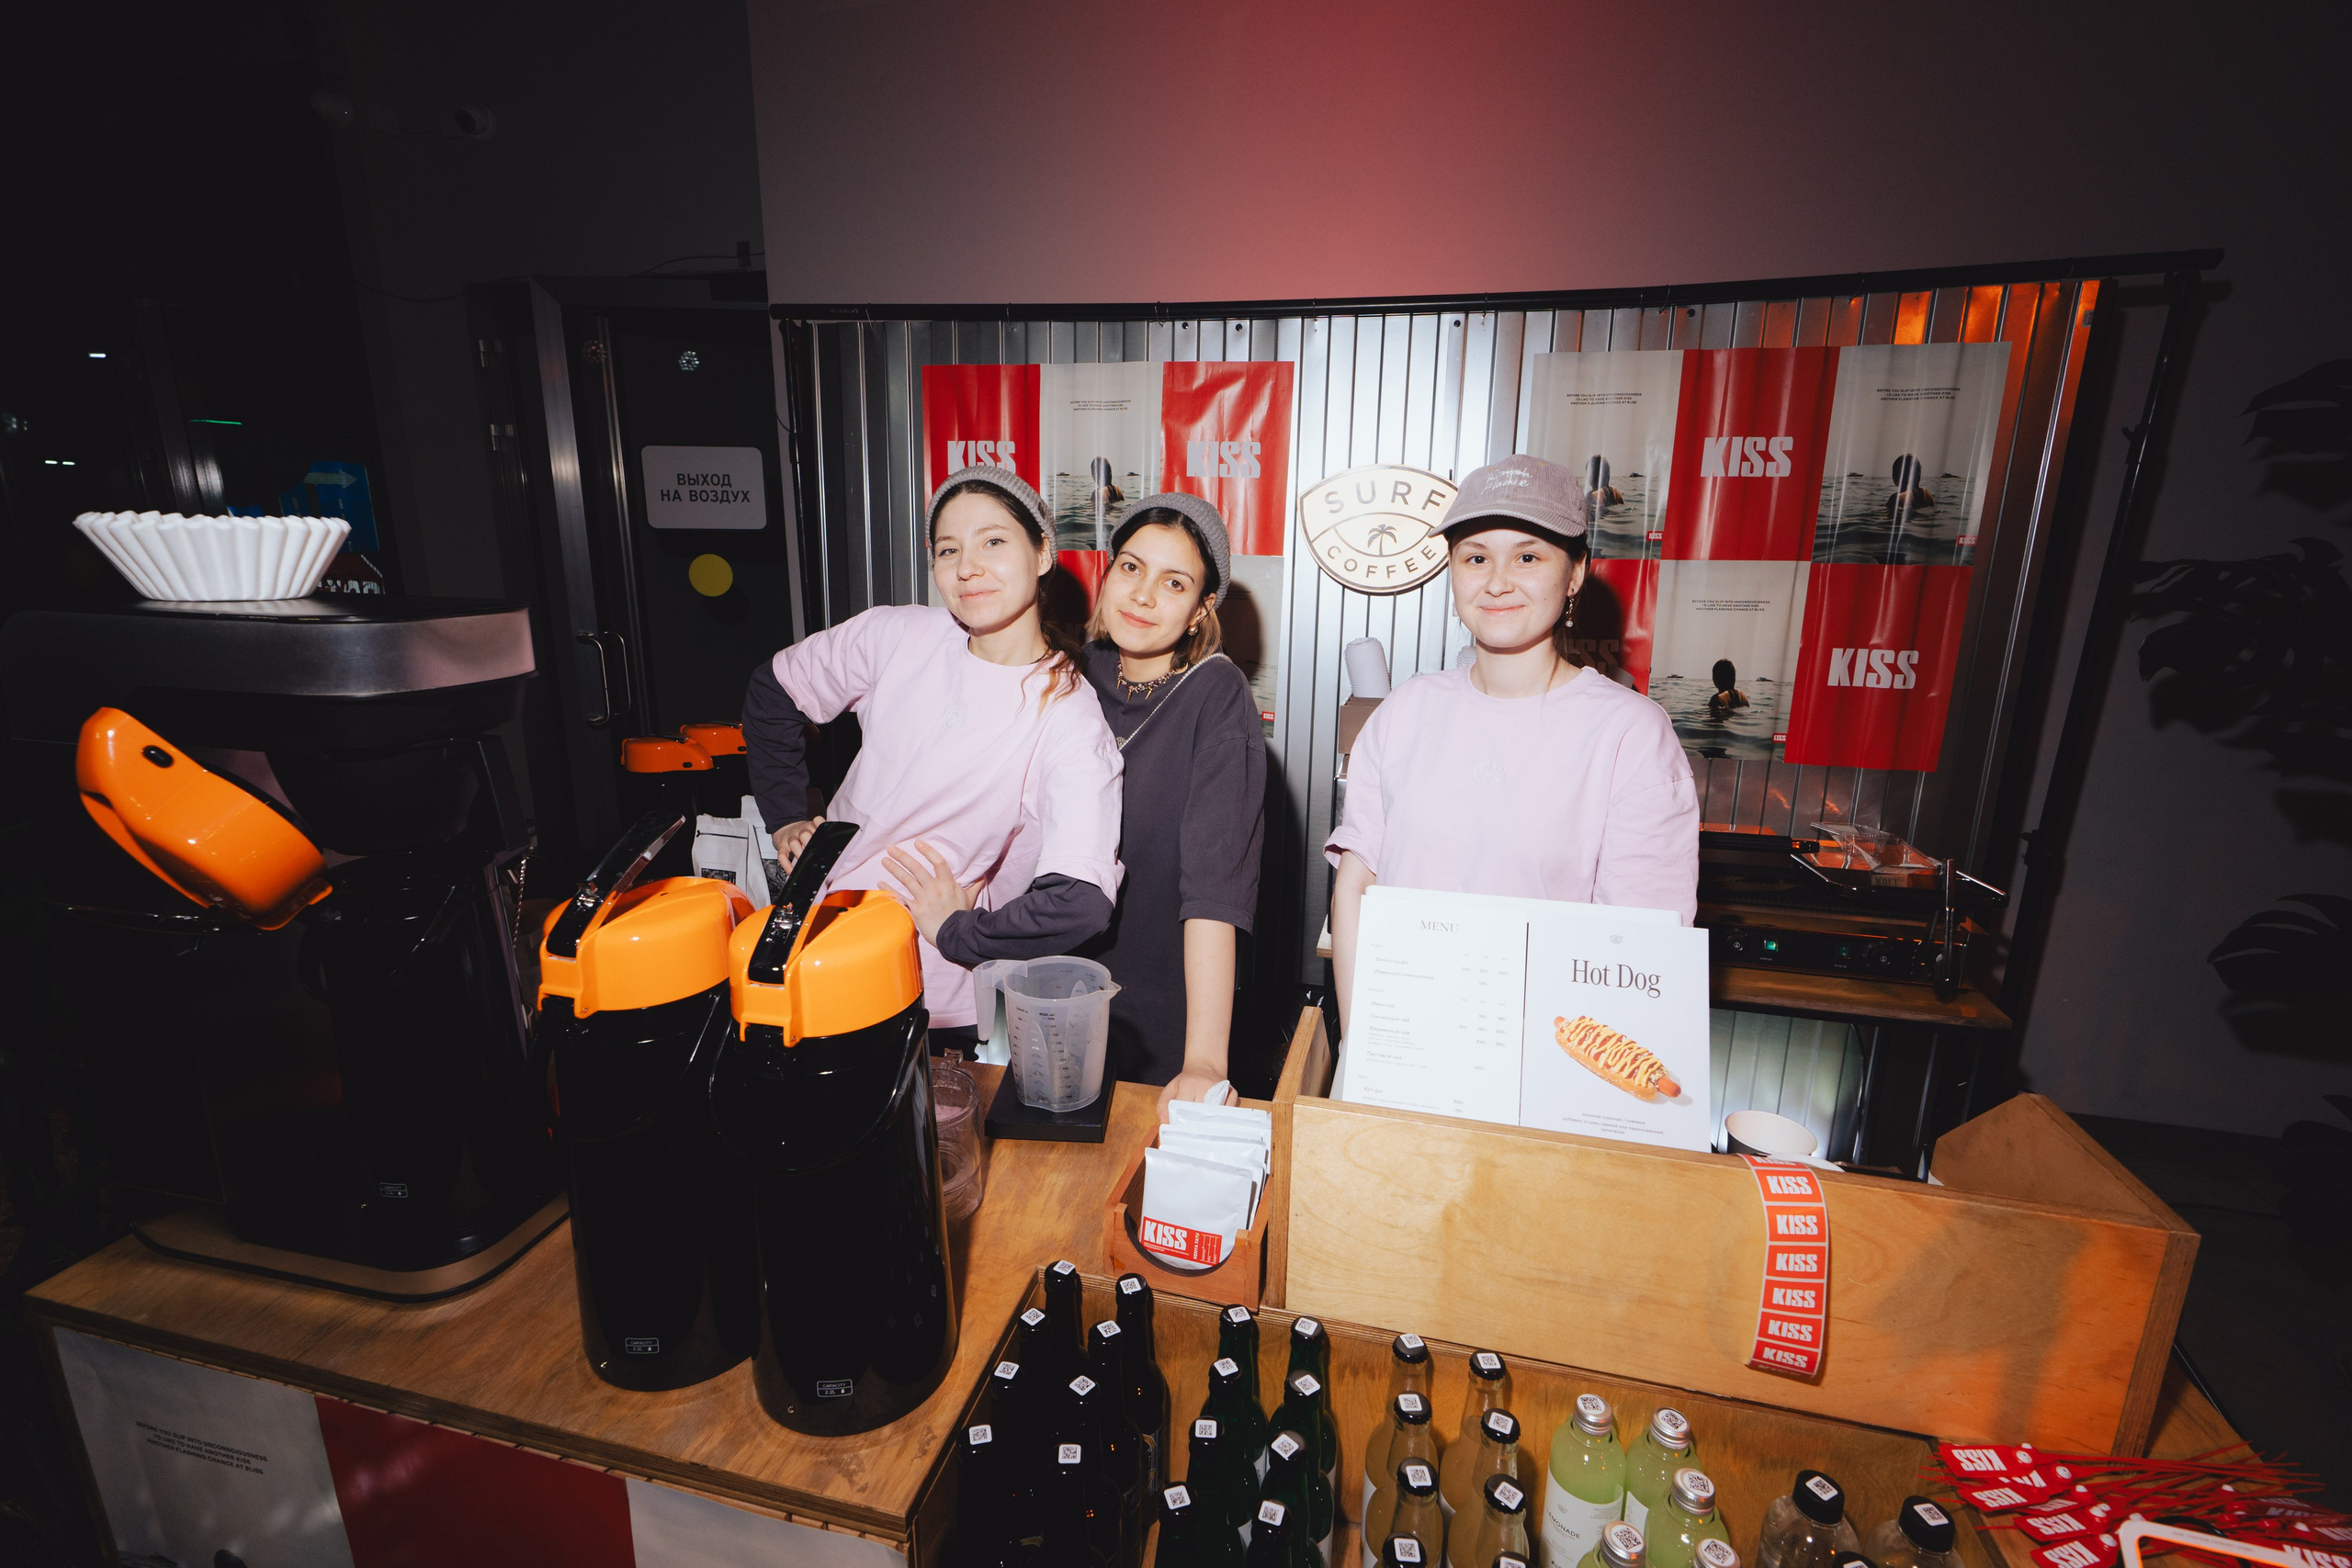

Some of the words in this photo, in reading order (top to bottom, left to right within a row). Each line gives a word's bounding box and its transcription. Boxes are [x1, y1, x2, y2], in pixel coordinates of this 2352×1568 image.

[947, 440, 1015, 476] KISS
[1187, 440, 1261, 478] KISS
[1701, 436, 1794, 478] KISS
[676, 473, 732, 488] ВЫХОД
[661, 490, 683, 502] НА
[689, 490, 751, 504] ВОЗДУХ
[1324, 480, 1446, 514] SURF
[1328, 545, 1437, 579] COFFEE
[1826, 648, 1919, 689] KISS
[1419, 919, 1460, 933] MENU
[1571, 958, 1611, 987] Hot
[1617, 964, 1661, 998] Dog
[1766, 1175, 1813, 1195] KISS
[1144, 1220, 1187, 1251] KISS
[1776, 1214, 1818, 1235] KISS
[1775, 1253, 1818, 1272] KISS
[1771, 1287, 1815, 1308] KISS
[1768, 1319, 1814, 1342] KISS
[1762, 1347, 1808, 1368] KISS
[136, 1421, 157, 1432] BEFORE
[159, 1428, 172, 1437] YOU
[173, 1431, 186, 1440] SLIP
[187, 1436, 202, 1445] INTO
[147, 1438, 175, 1451] ANOTHER
[175, 1446, 207, 1460] FLASHING
[207, 1455, 234, 1468] CHANCE
[244, 1465, 264, 1474] BLISS
[163, 1436, 176, 1445] LIKE
[187, 1443, 203, 1452] HAVE
[204, 1448, 235, 1461] ANOTHER
[236, 1456, 252, 1464] KISS
[1951, 1449, 2007, 1472] KISS
[1972, 1487, 2028, 1507] KISS
[1546, 1507, 1581, 1539] LEMONADE
[2026, 1513, 2086, 1536] KISS
[2042, 1540, 2101, 1568] KISS
